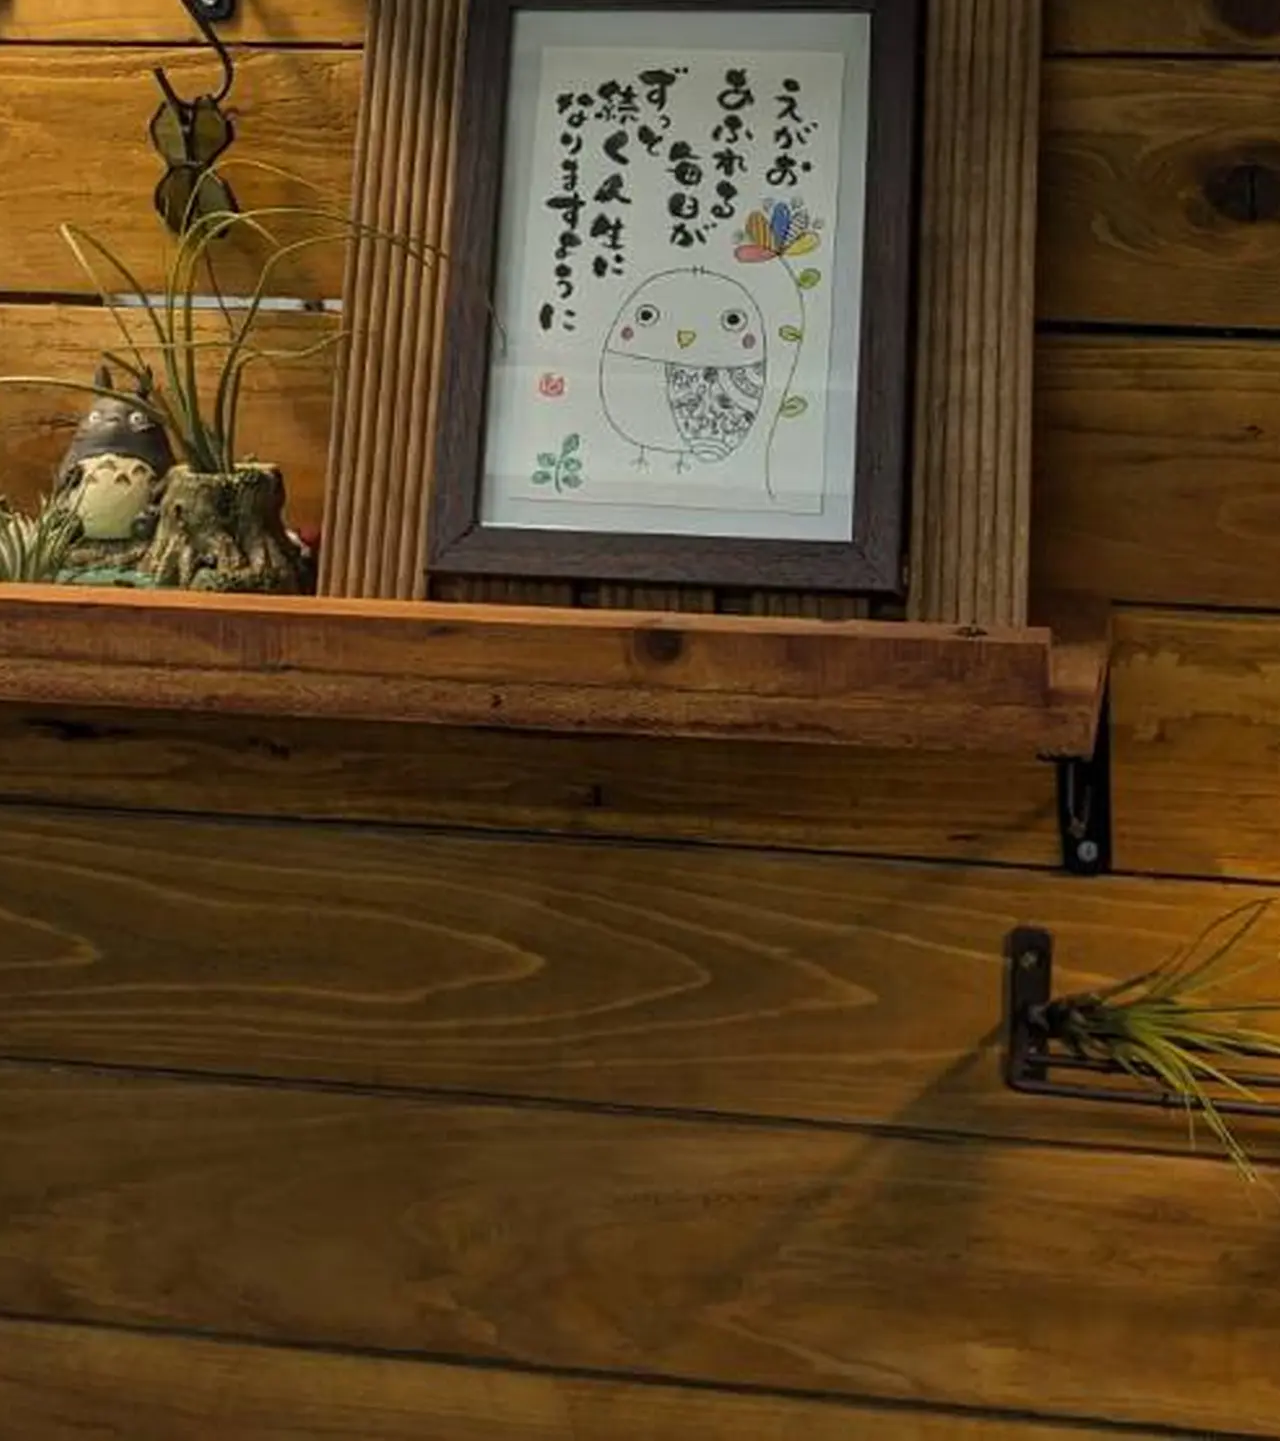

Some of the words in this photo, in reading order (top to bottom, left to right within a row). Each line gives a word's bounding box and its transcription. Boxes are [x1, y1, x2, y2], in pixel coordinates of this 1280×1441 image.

[637, 66, 689, 157] ずっと
[710, 68, 755, 219] あふれる
[765, 78, 818, 186] えがお
[538, 92, 595, 331] なりますように
[665, 141, 718, 247] 毎日が
